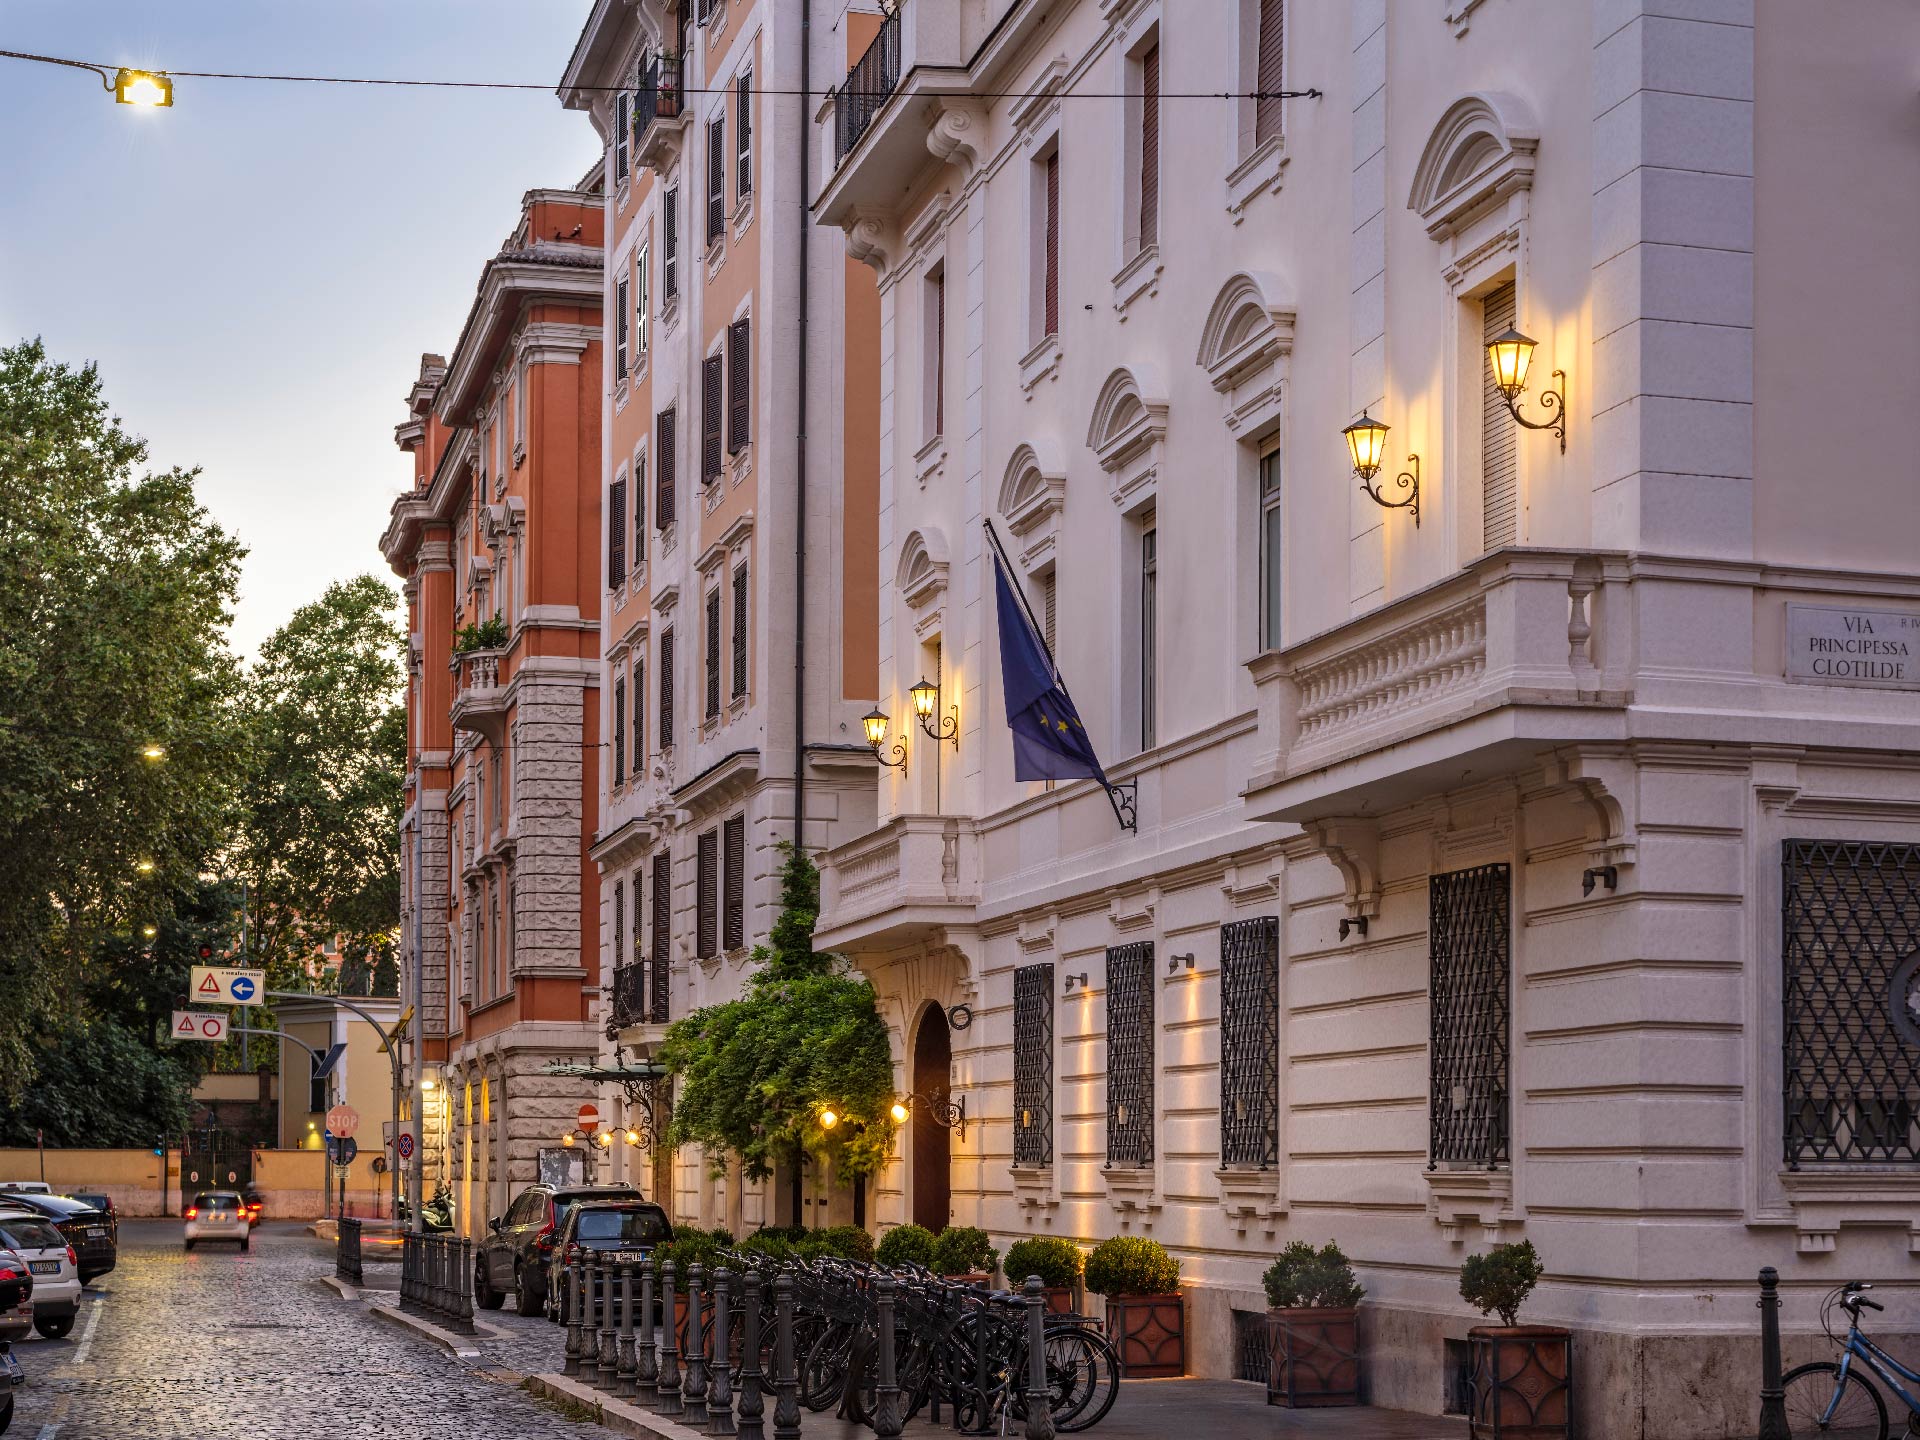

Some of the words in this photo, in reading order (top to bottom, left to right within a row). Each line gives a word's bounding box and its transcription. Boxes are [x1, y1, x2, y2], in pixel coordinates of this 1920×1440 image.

[1843, 616, 1874, 634] VIA
[1809, 637, 1909, 656] PRINCIPESSA
[1813, 658, 1905, 679] CLOTILDE
[329, 1115, 358, 1128] STOP
